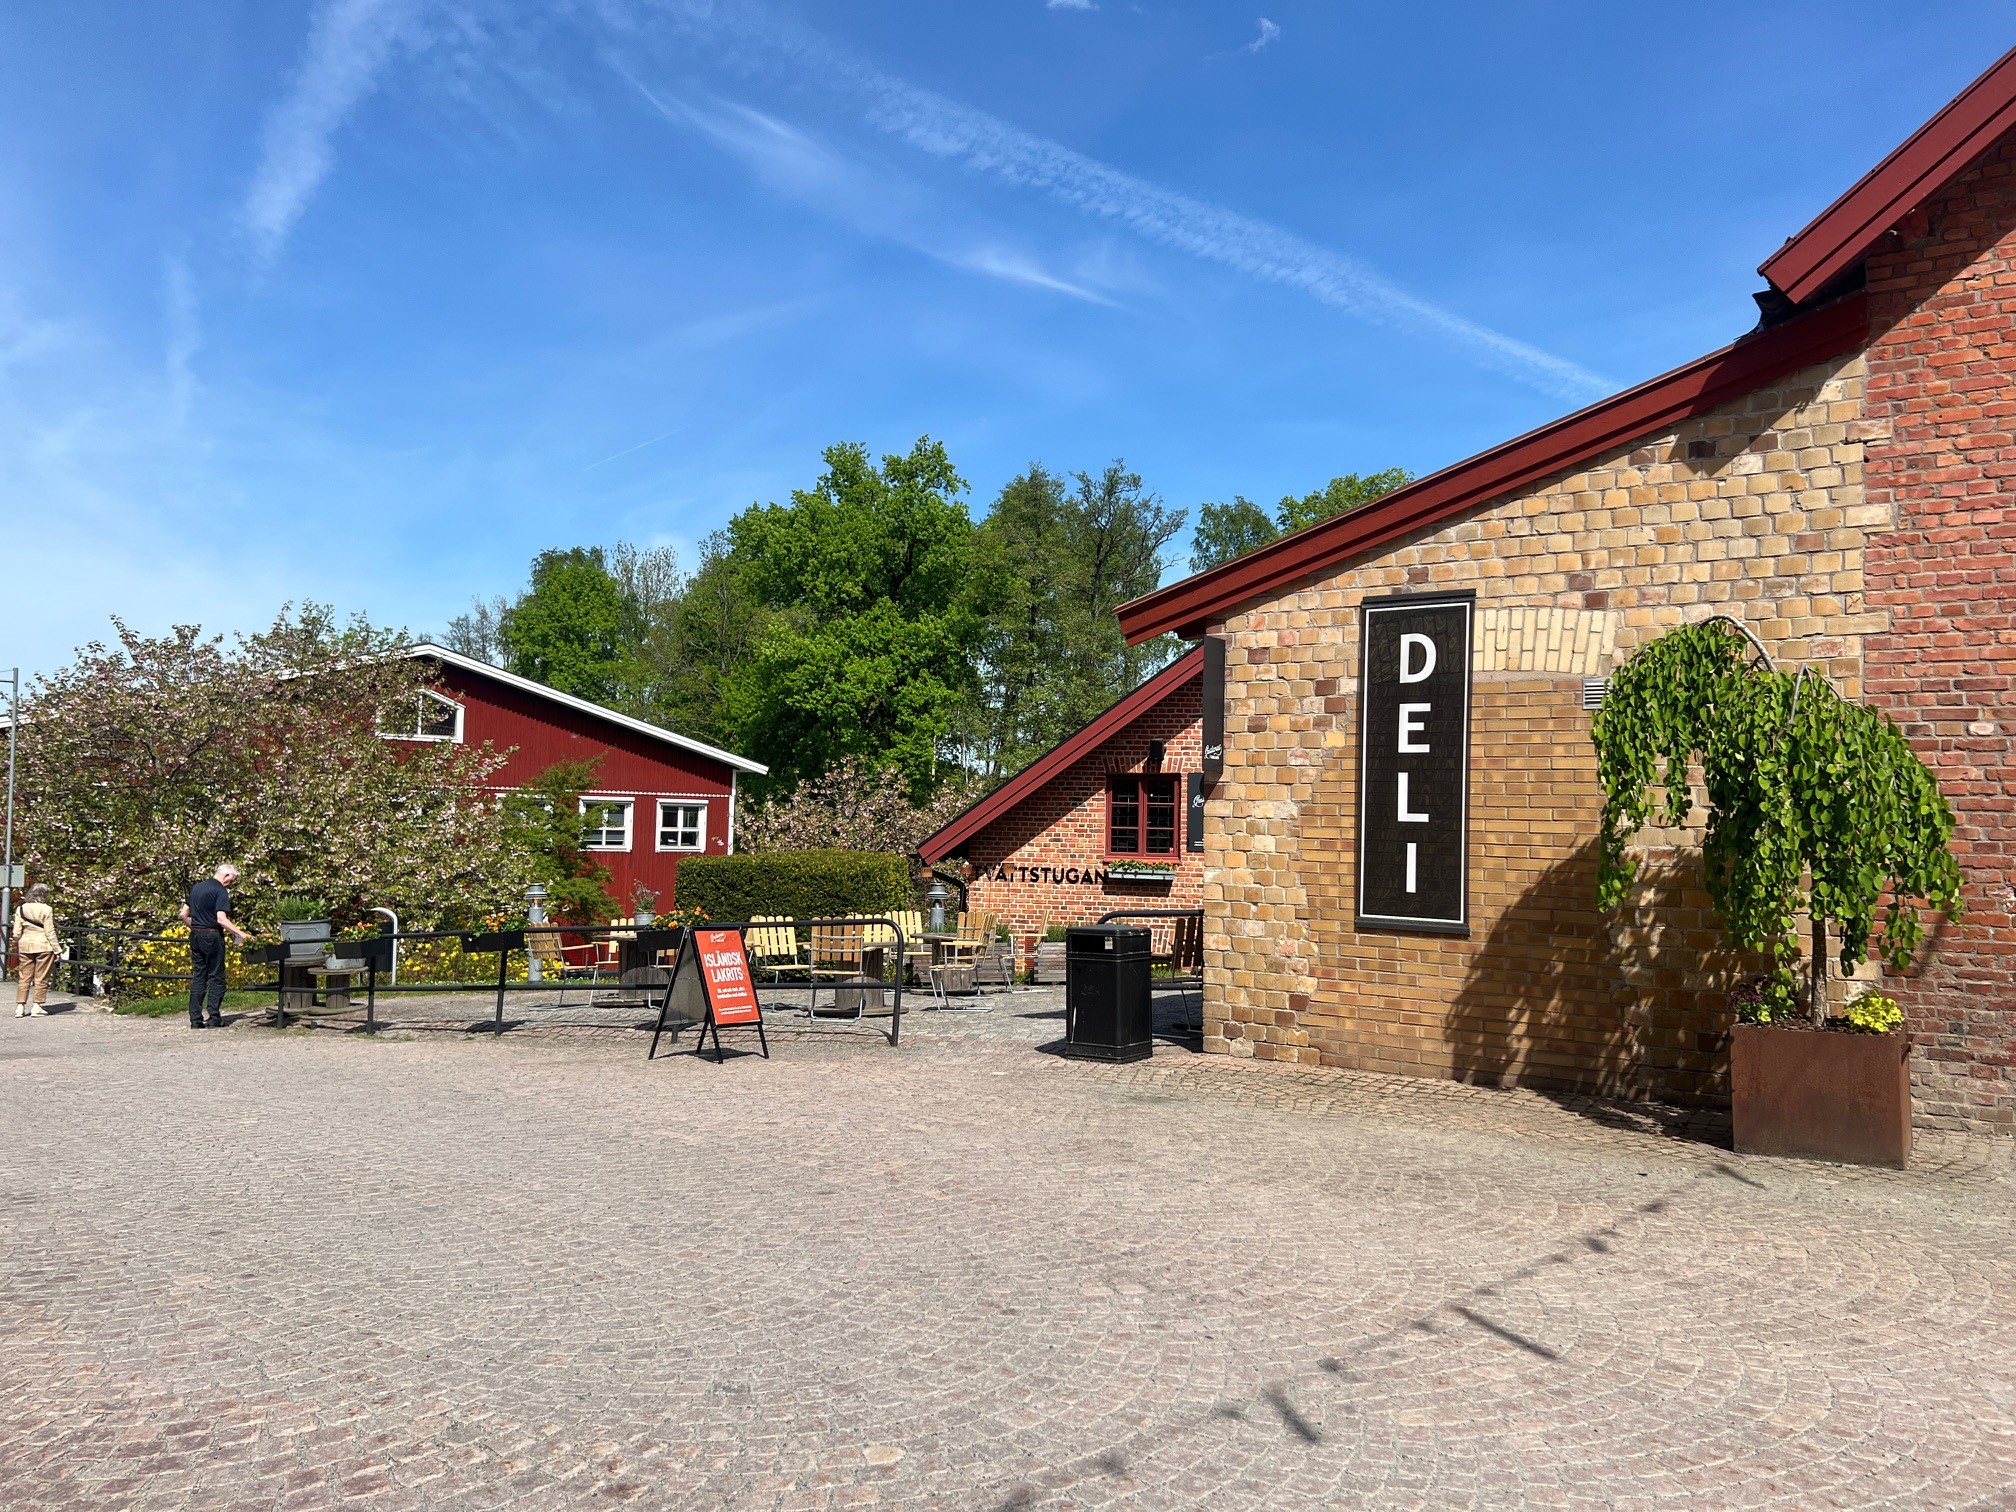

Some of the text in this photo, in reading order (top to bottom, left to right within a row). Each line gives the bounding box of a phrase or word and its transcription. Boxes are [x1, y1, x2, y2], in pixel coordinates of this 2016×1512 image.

[1396, 632, 1437, 893] DELI
[703, 950, 743, 968] ISLÄNDSK
[711, 966, 744, 983] LAKRITS
